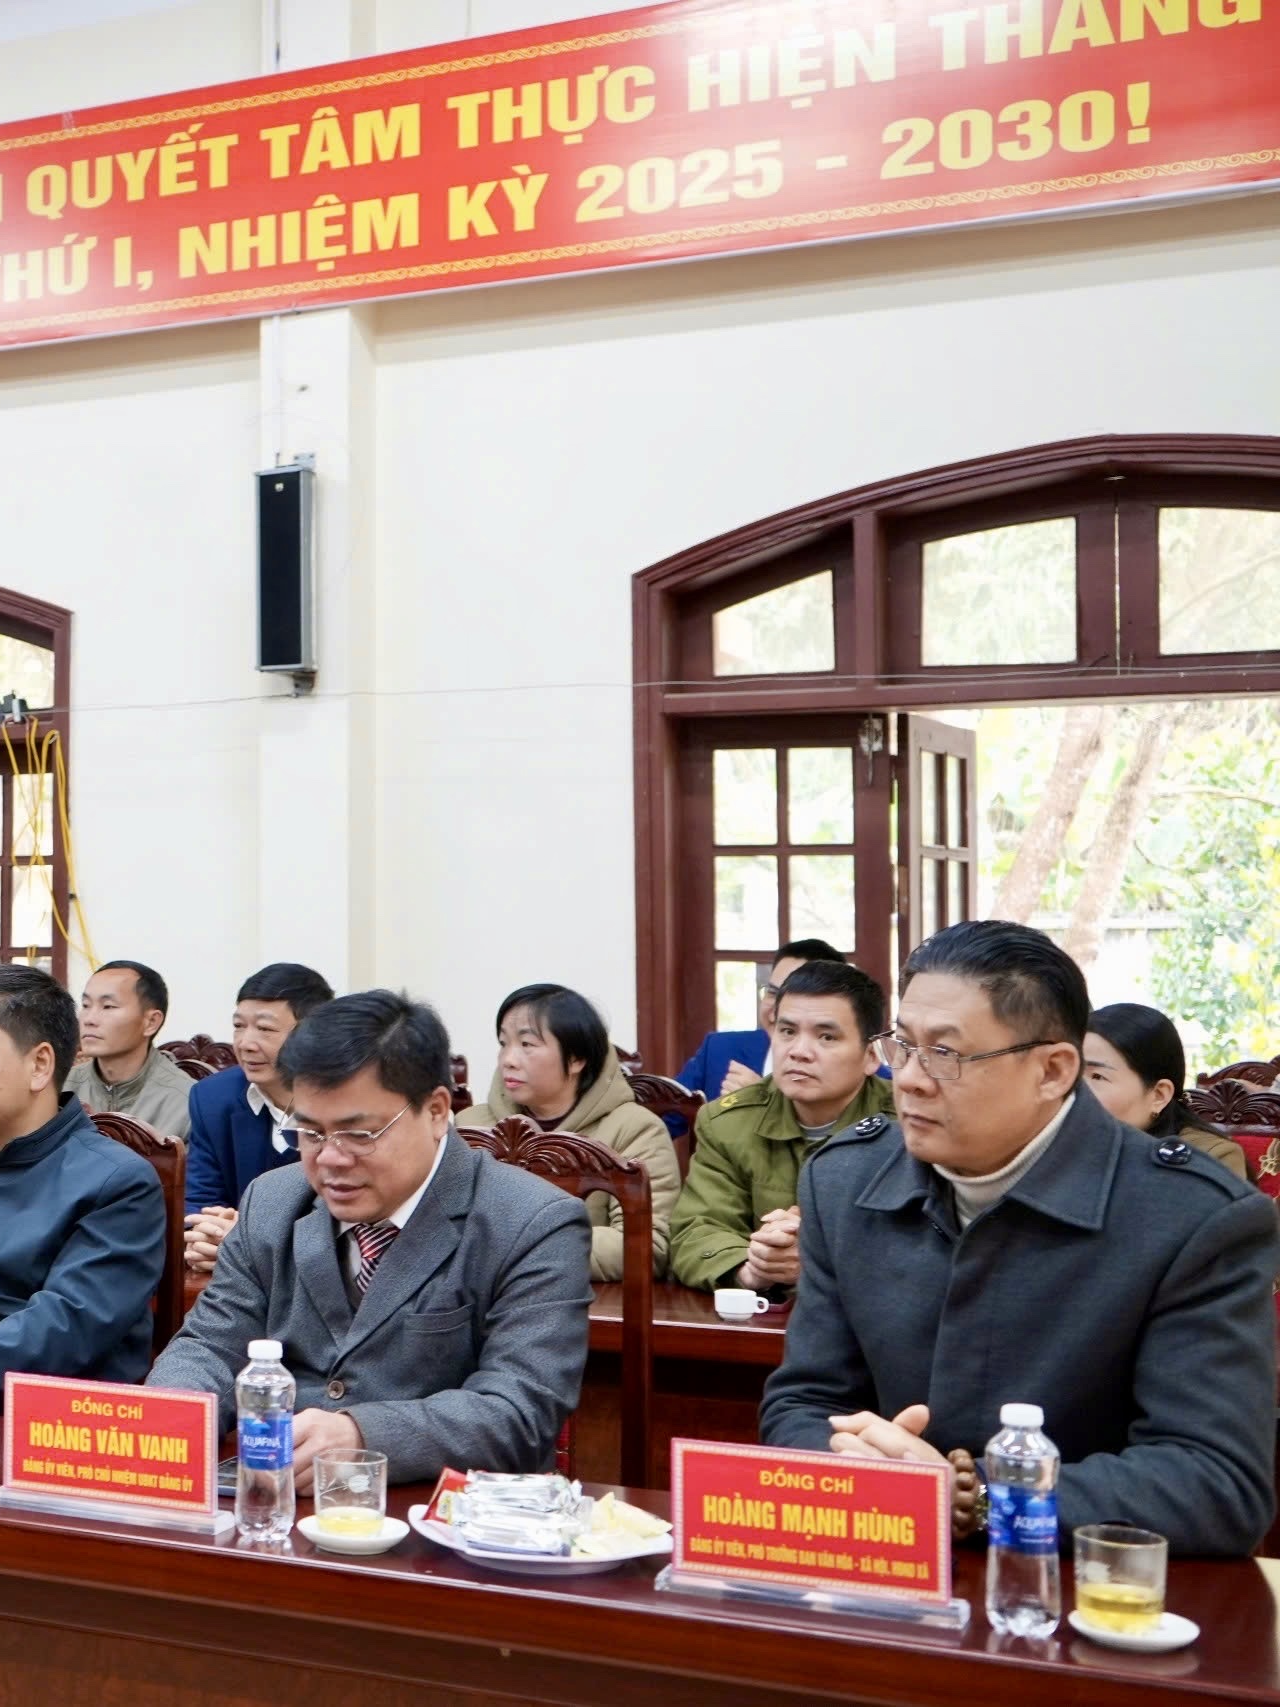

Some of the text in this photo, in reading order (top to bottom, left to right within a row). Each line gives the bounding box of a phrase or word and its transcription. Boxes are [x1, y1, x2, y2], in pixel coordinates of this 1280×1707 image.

[26, 123, 239, 220] QUYẾT
[261, 105, 421, 180] TÂM
[447, 65, 656, 145] THỰC
[688, 23, 897, 112] HIỆN
[113, 237, 155, 291] I,
[178, 193, 419, 279] NHIỆM
[448, 164, 549, 241] KỲ
[575, 139, 784, 224] 2025
[815, 155, 848, 171] -
[879, 81, 1151, 181] 2030!
[117, 1402, 144, 1420] CHÍ
[29, 1419, 189, 1465] HOÀNG VĂN VANH
[820, 1475, 855, 1494] CHÍ
[703, 1491, 916, 1547] HOÀNG MẠNH HÙNG
